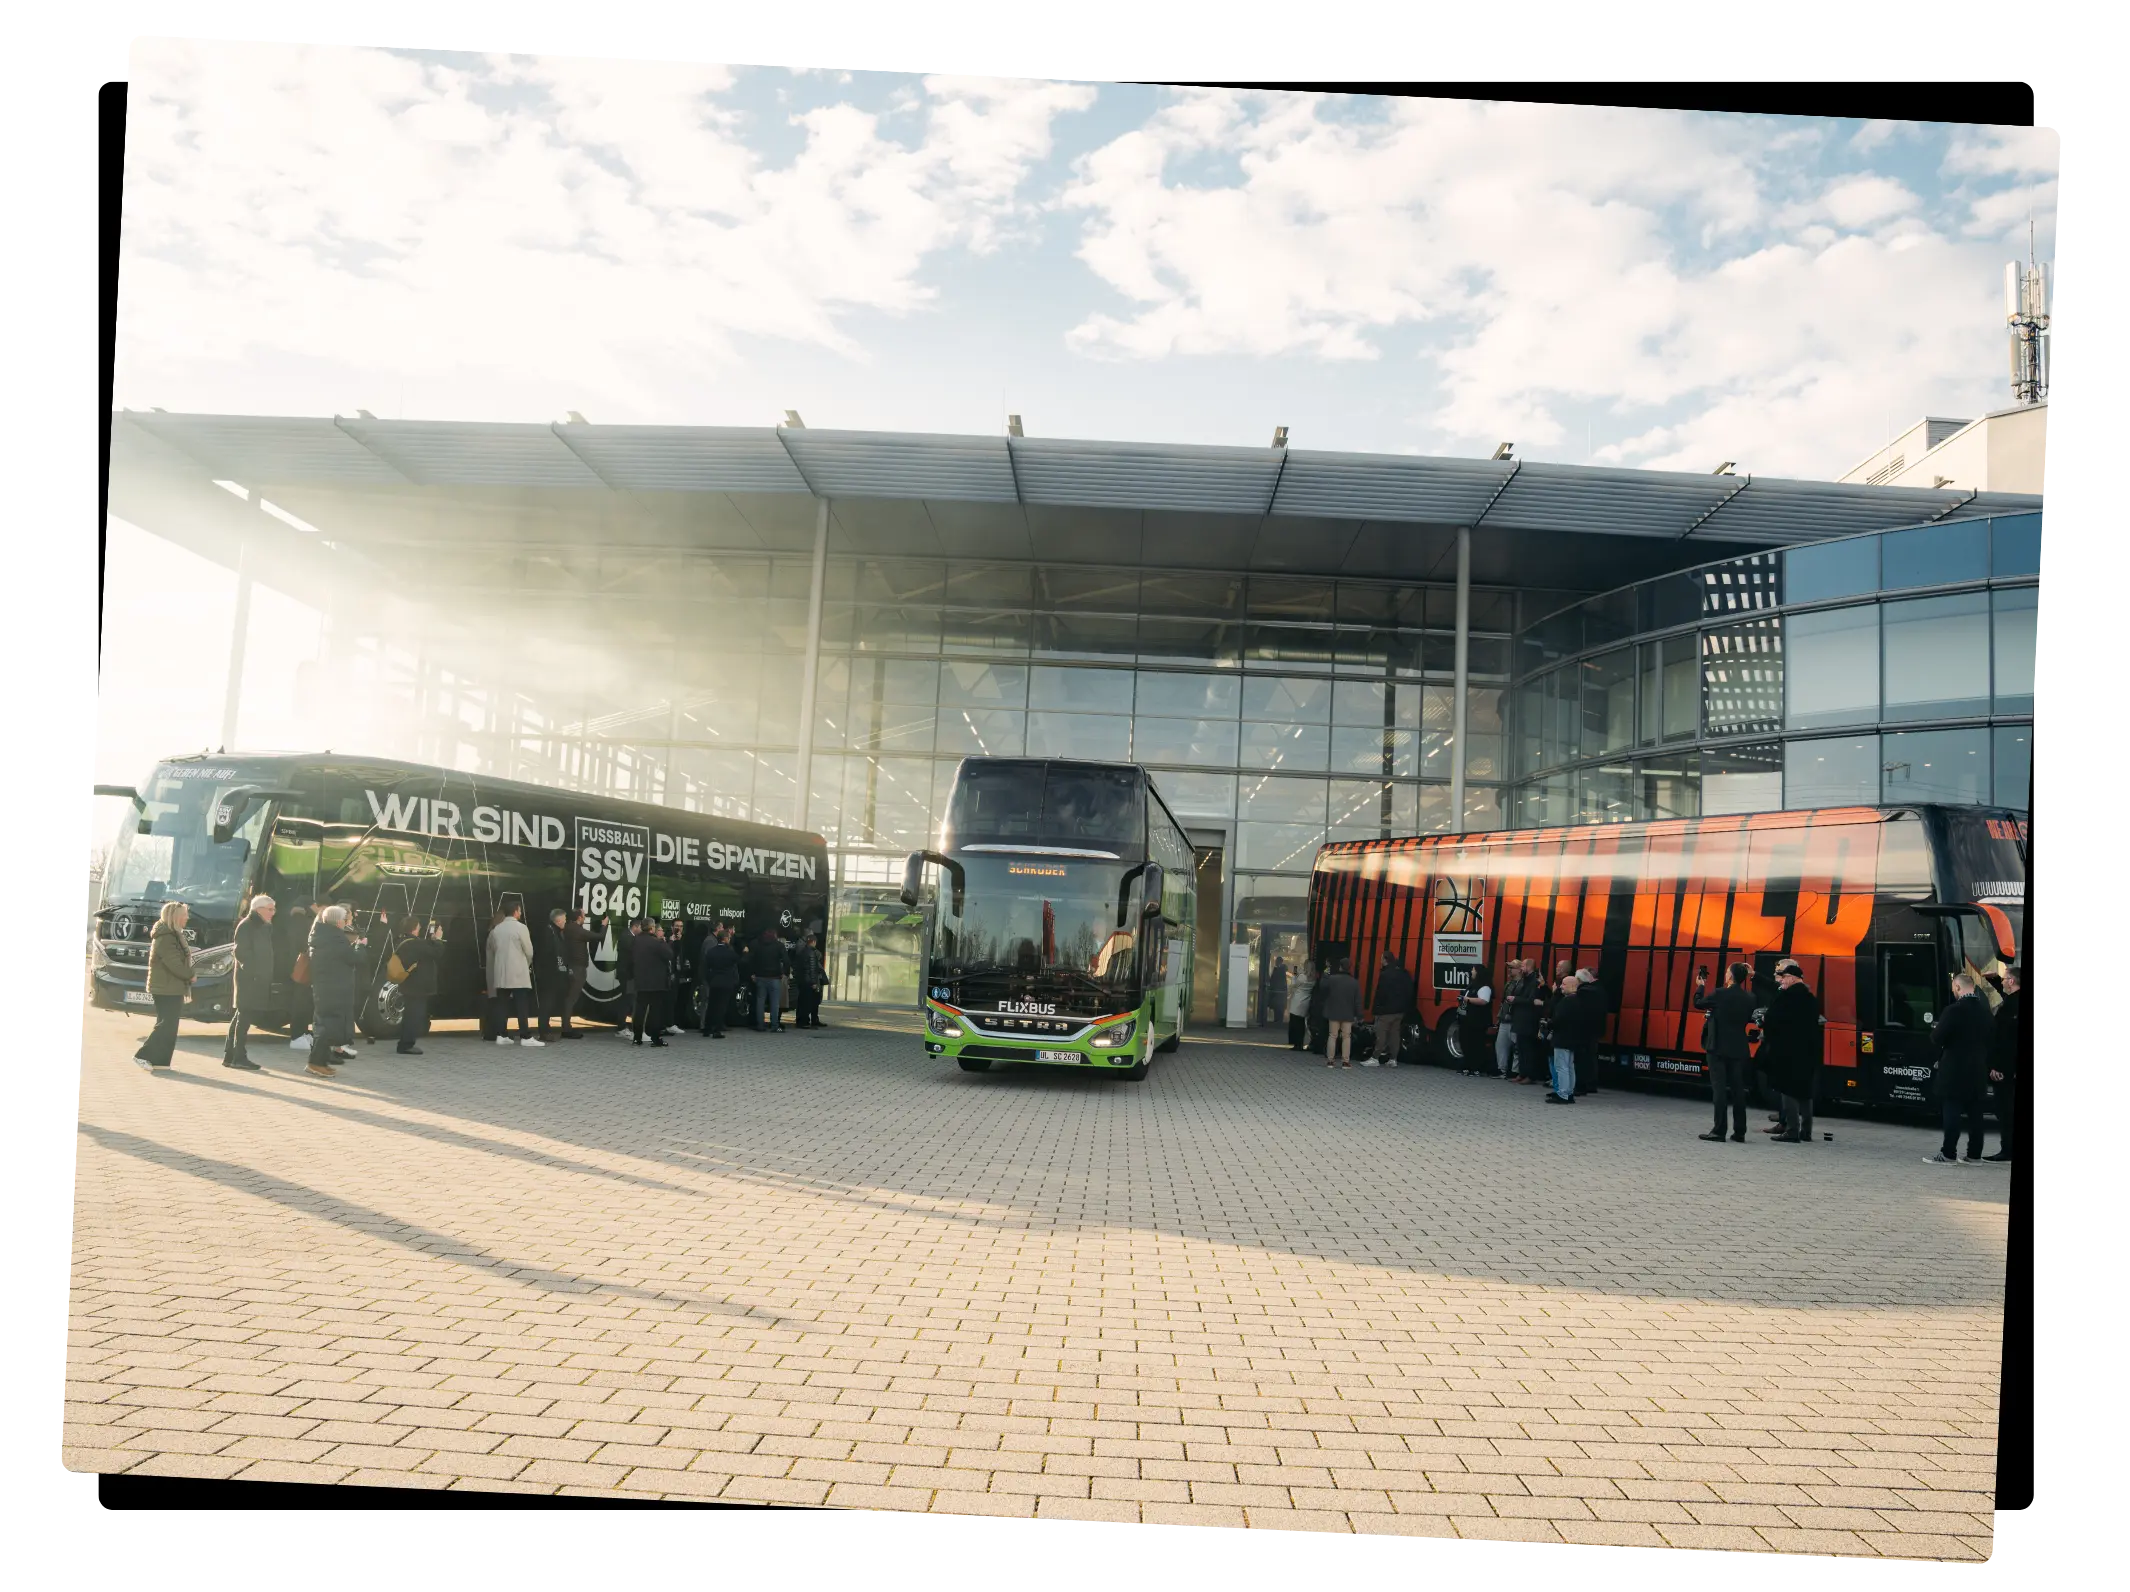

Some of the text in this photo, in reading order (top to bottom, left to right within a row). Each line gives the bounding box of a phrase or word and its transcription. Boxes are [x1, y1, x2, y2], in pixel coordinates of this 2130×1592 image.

[365, 789, 566, 850] WIR SIND
[581, 825, 645, 848] FUSSBALL
[656, 833, 816, 881] DIE SPATZEN
[580, 846, 645, 884] SSV
[578, 881, 642, 918] 1846
[662, 900, 680, 909] LIQUI
[661, 909, 680, 919] MOLY
[719, 908, 746, 920] uhlsport
[1438, 943, 1477, 954] ratiopharm
[1444, 966, 1470, 985] ulm
[985, 1017, 1068, 1031] SETRA
[1040, 1051, 1049, 1060] UL
[1053, 1052, 1062, 1061] SC
[1634, 1055, 1650, 1063] LIQUI
[1634, 1062, 1651, 1070] MOLY
[1656, 1060, 1700, 1073] ratiopharm
[1883, 1065, 1923, 1078] SCHRÖDER
